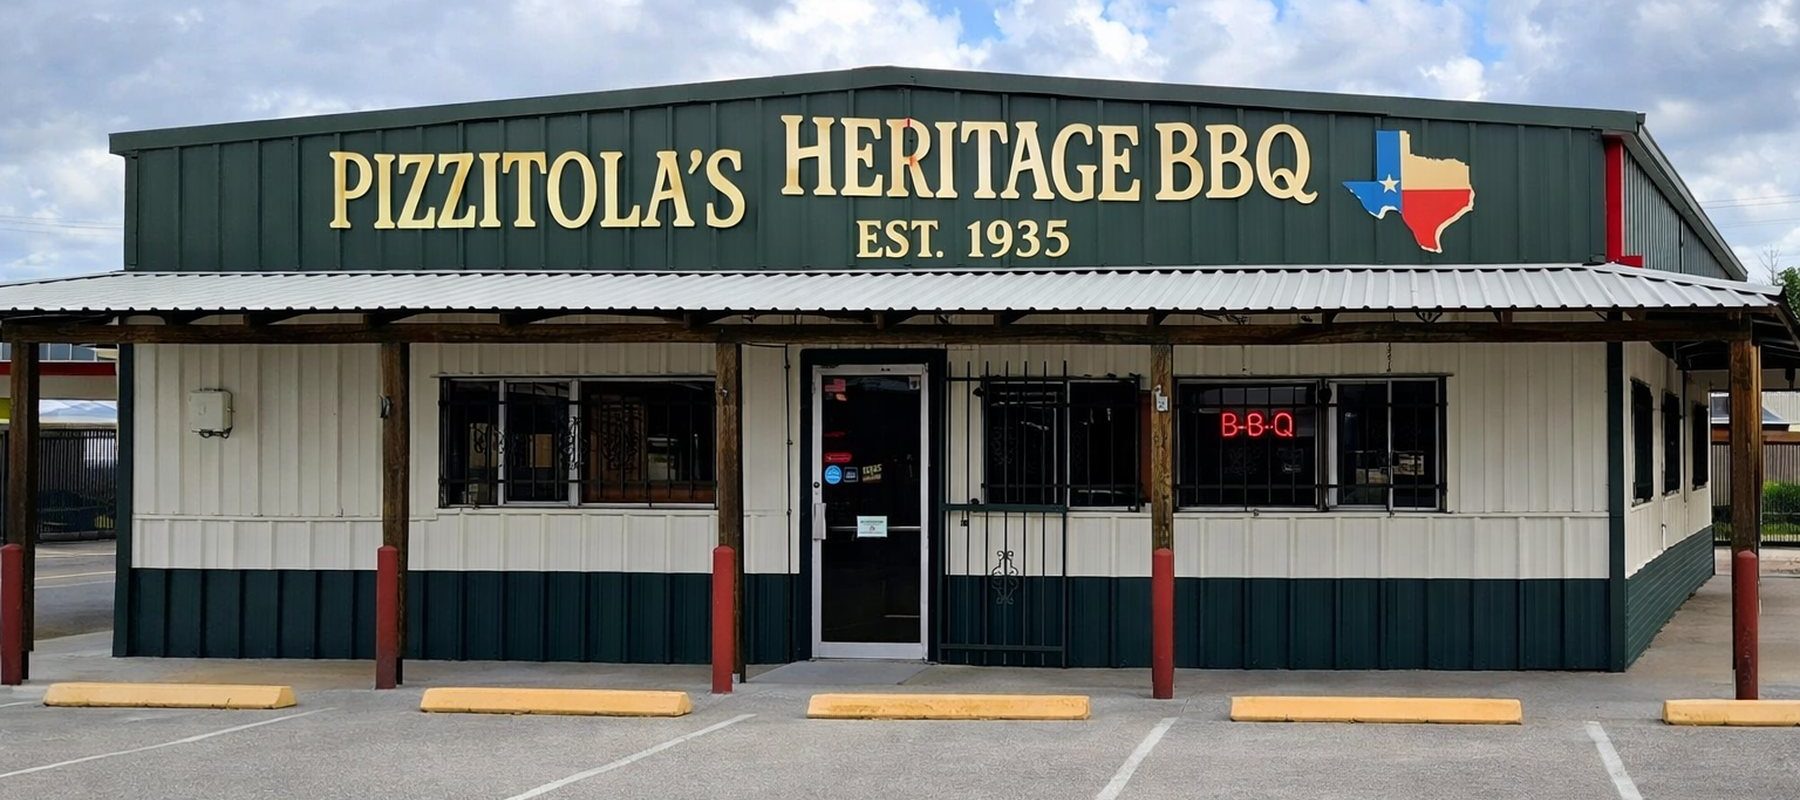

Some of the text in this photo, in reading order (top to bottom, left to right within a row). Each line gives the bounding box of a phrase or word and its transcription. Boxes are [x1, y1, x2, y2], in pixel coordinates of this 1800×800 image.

[331, 149, 746, 228] PIZZITOLA'S
[782, 115, 1317, 204] HERITAGE BBQ
[857, 220, 1071, 258] EST. 1935
